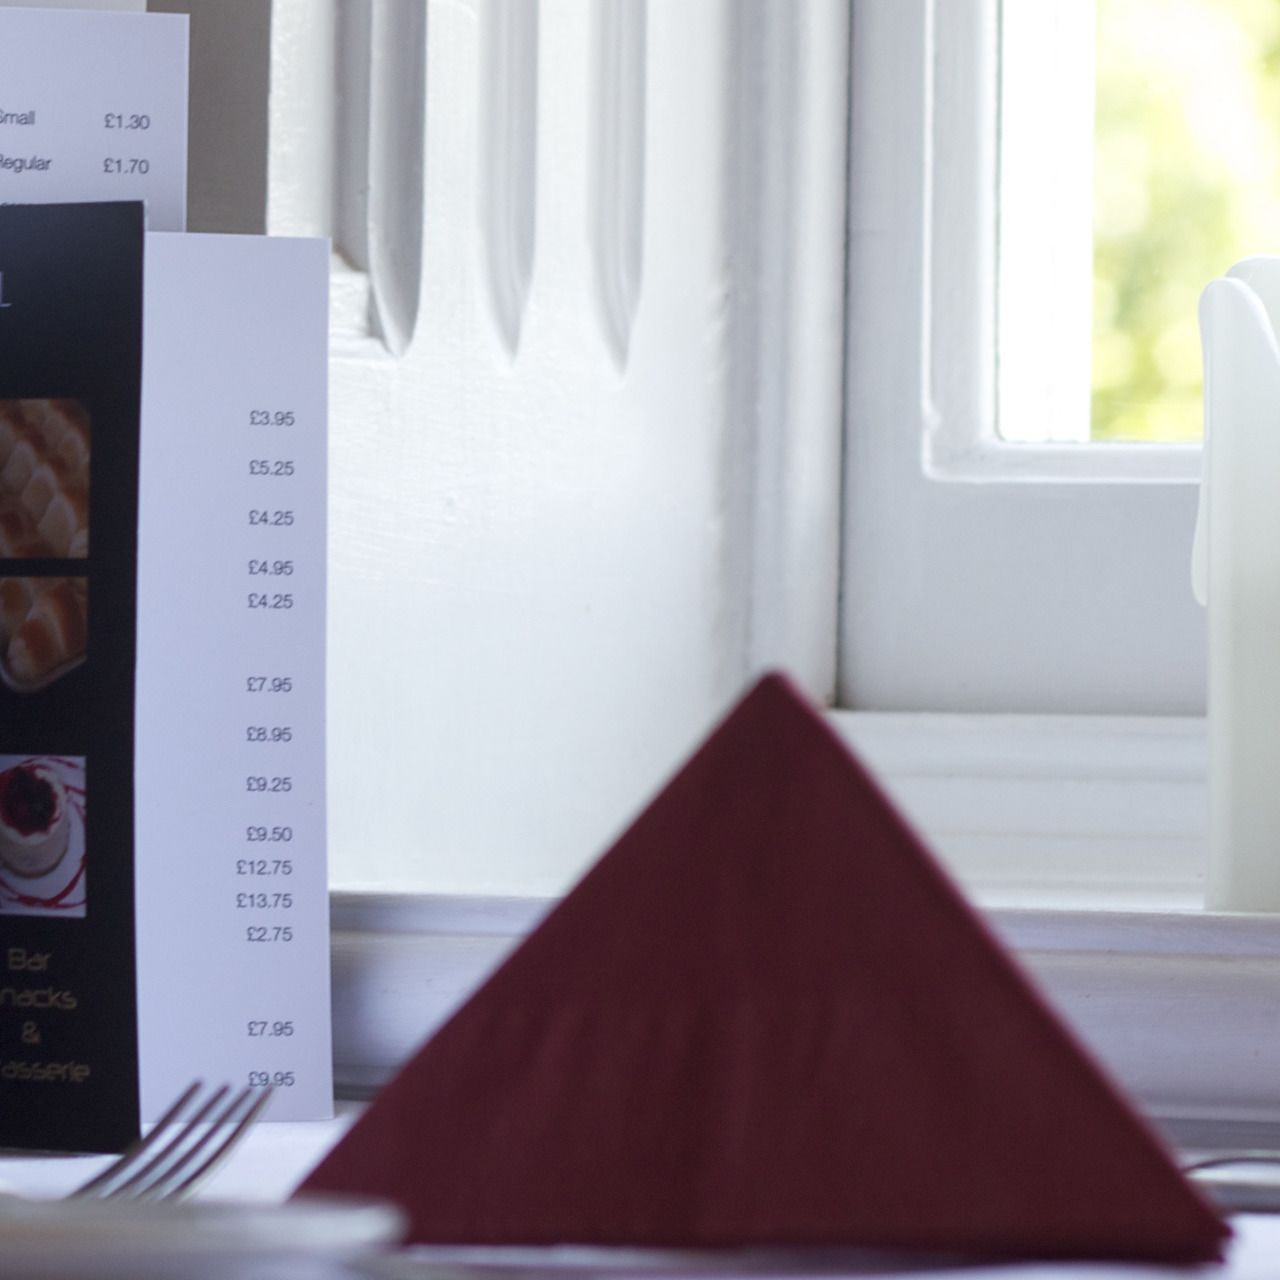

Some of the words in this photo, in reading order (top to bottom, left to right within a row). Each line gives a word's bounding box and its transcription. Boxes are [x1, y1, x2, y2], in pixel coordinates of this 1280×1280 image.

[104, 112, 151, 131] £1.30
[103, 157, 150, 175] £1.70
[249, 409, 296, 427] £3.95
[249, 459, 295, 477] £5.25
[248, 509, 295, 527] £4.25
[248, 559, 294, 577] £4.95
[247, 592, 294, 610] £4.25
[246, 676, 293, 694] £7.95
[246, 726, 293, 743] £8.95
[246, 776, 293, 793] £9.25
[246, 825, 293, 843] £9.50
[236, 859, 293, 876] £12.75
[236, 892, 293, 909] £13.75
[246, 925, 294, 943] £2.75
[8, 947, 51, 971] Bar
[22, 1020, 42, 1044] &
[247, 1020, 295, 1037] £7.95
[248, 1071, 297, 1087] £995
